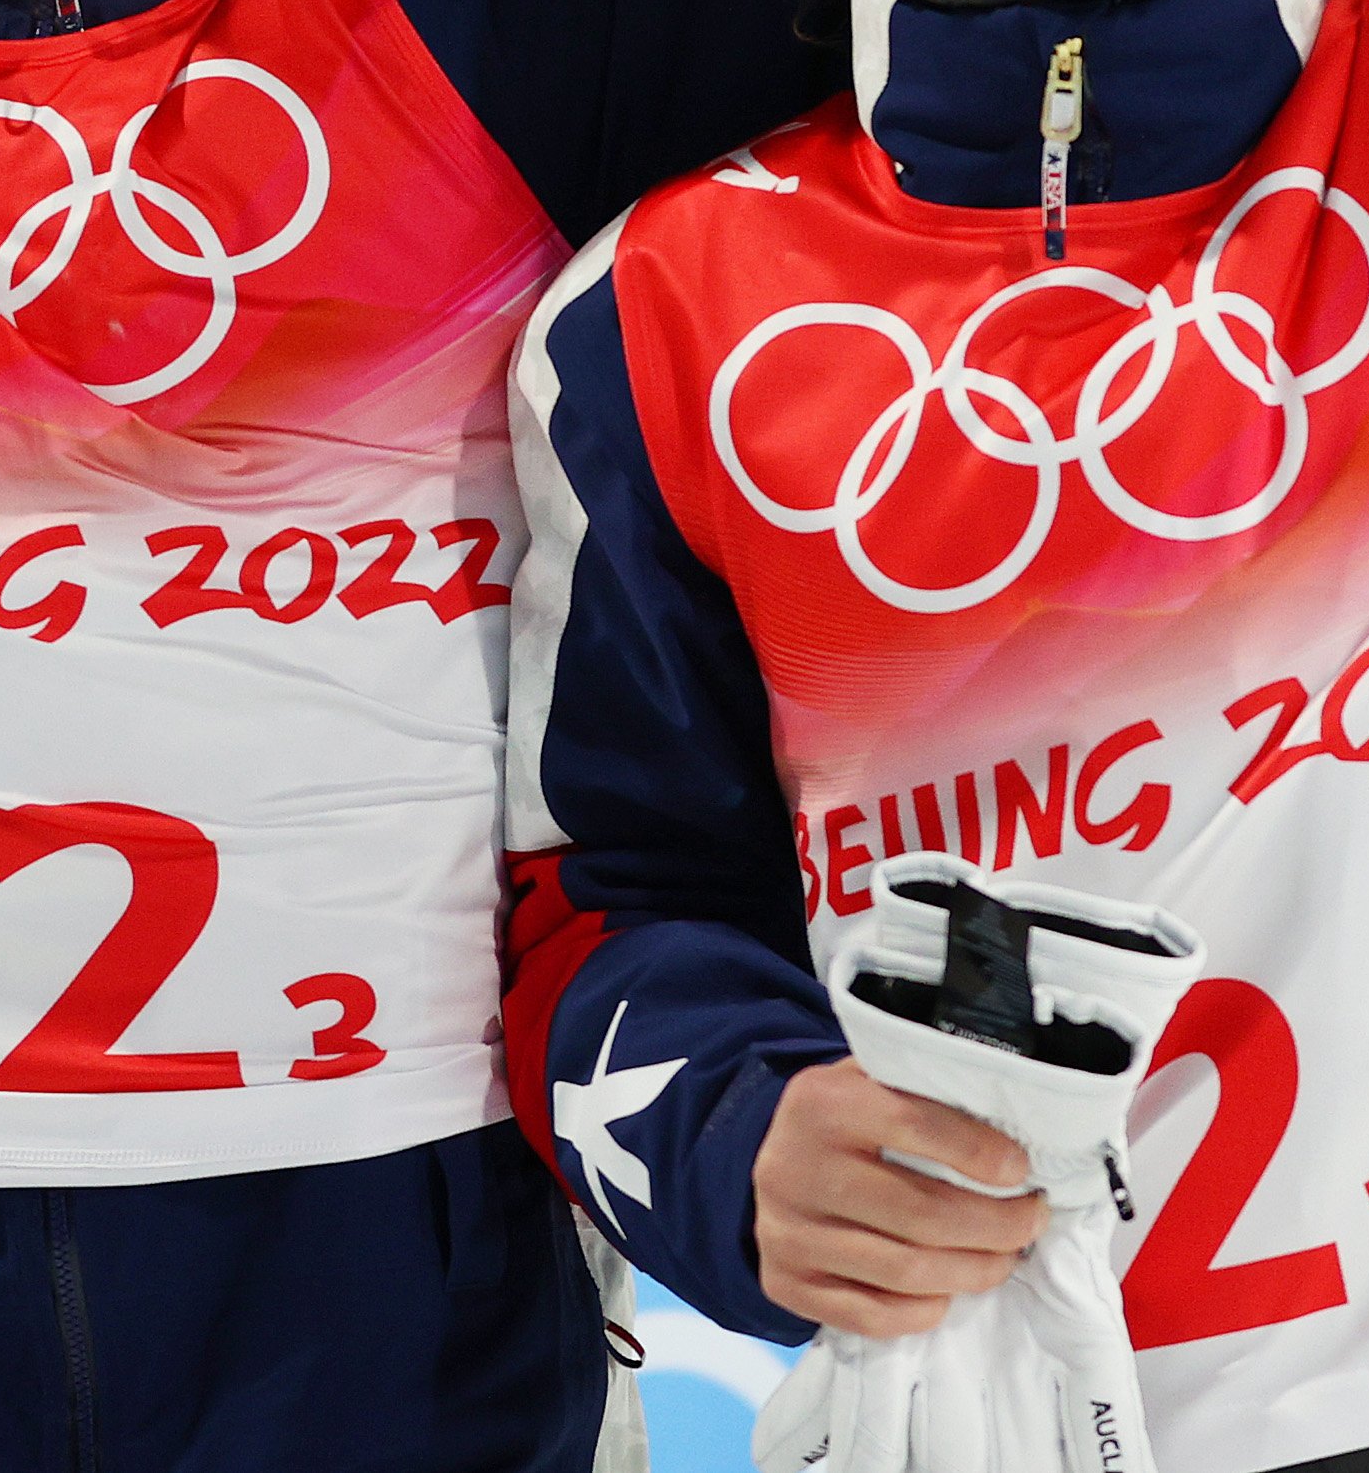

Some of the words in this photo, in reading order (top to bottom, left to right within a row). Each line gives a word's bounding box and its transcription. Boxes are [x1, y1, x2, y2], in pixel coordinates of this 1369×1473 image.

[137, 517, 510, 630] 2022
[282, 972, 388, 1082] 3
[1120, 977, 1349, 1352] 2
[1090, 1399, 1124, 1473] AUCL
